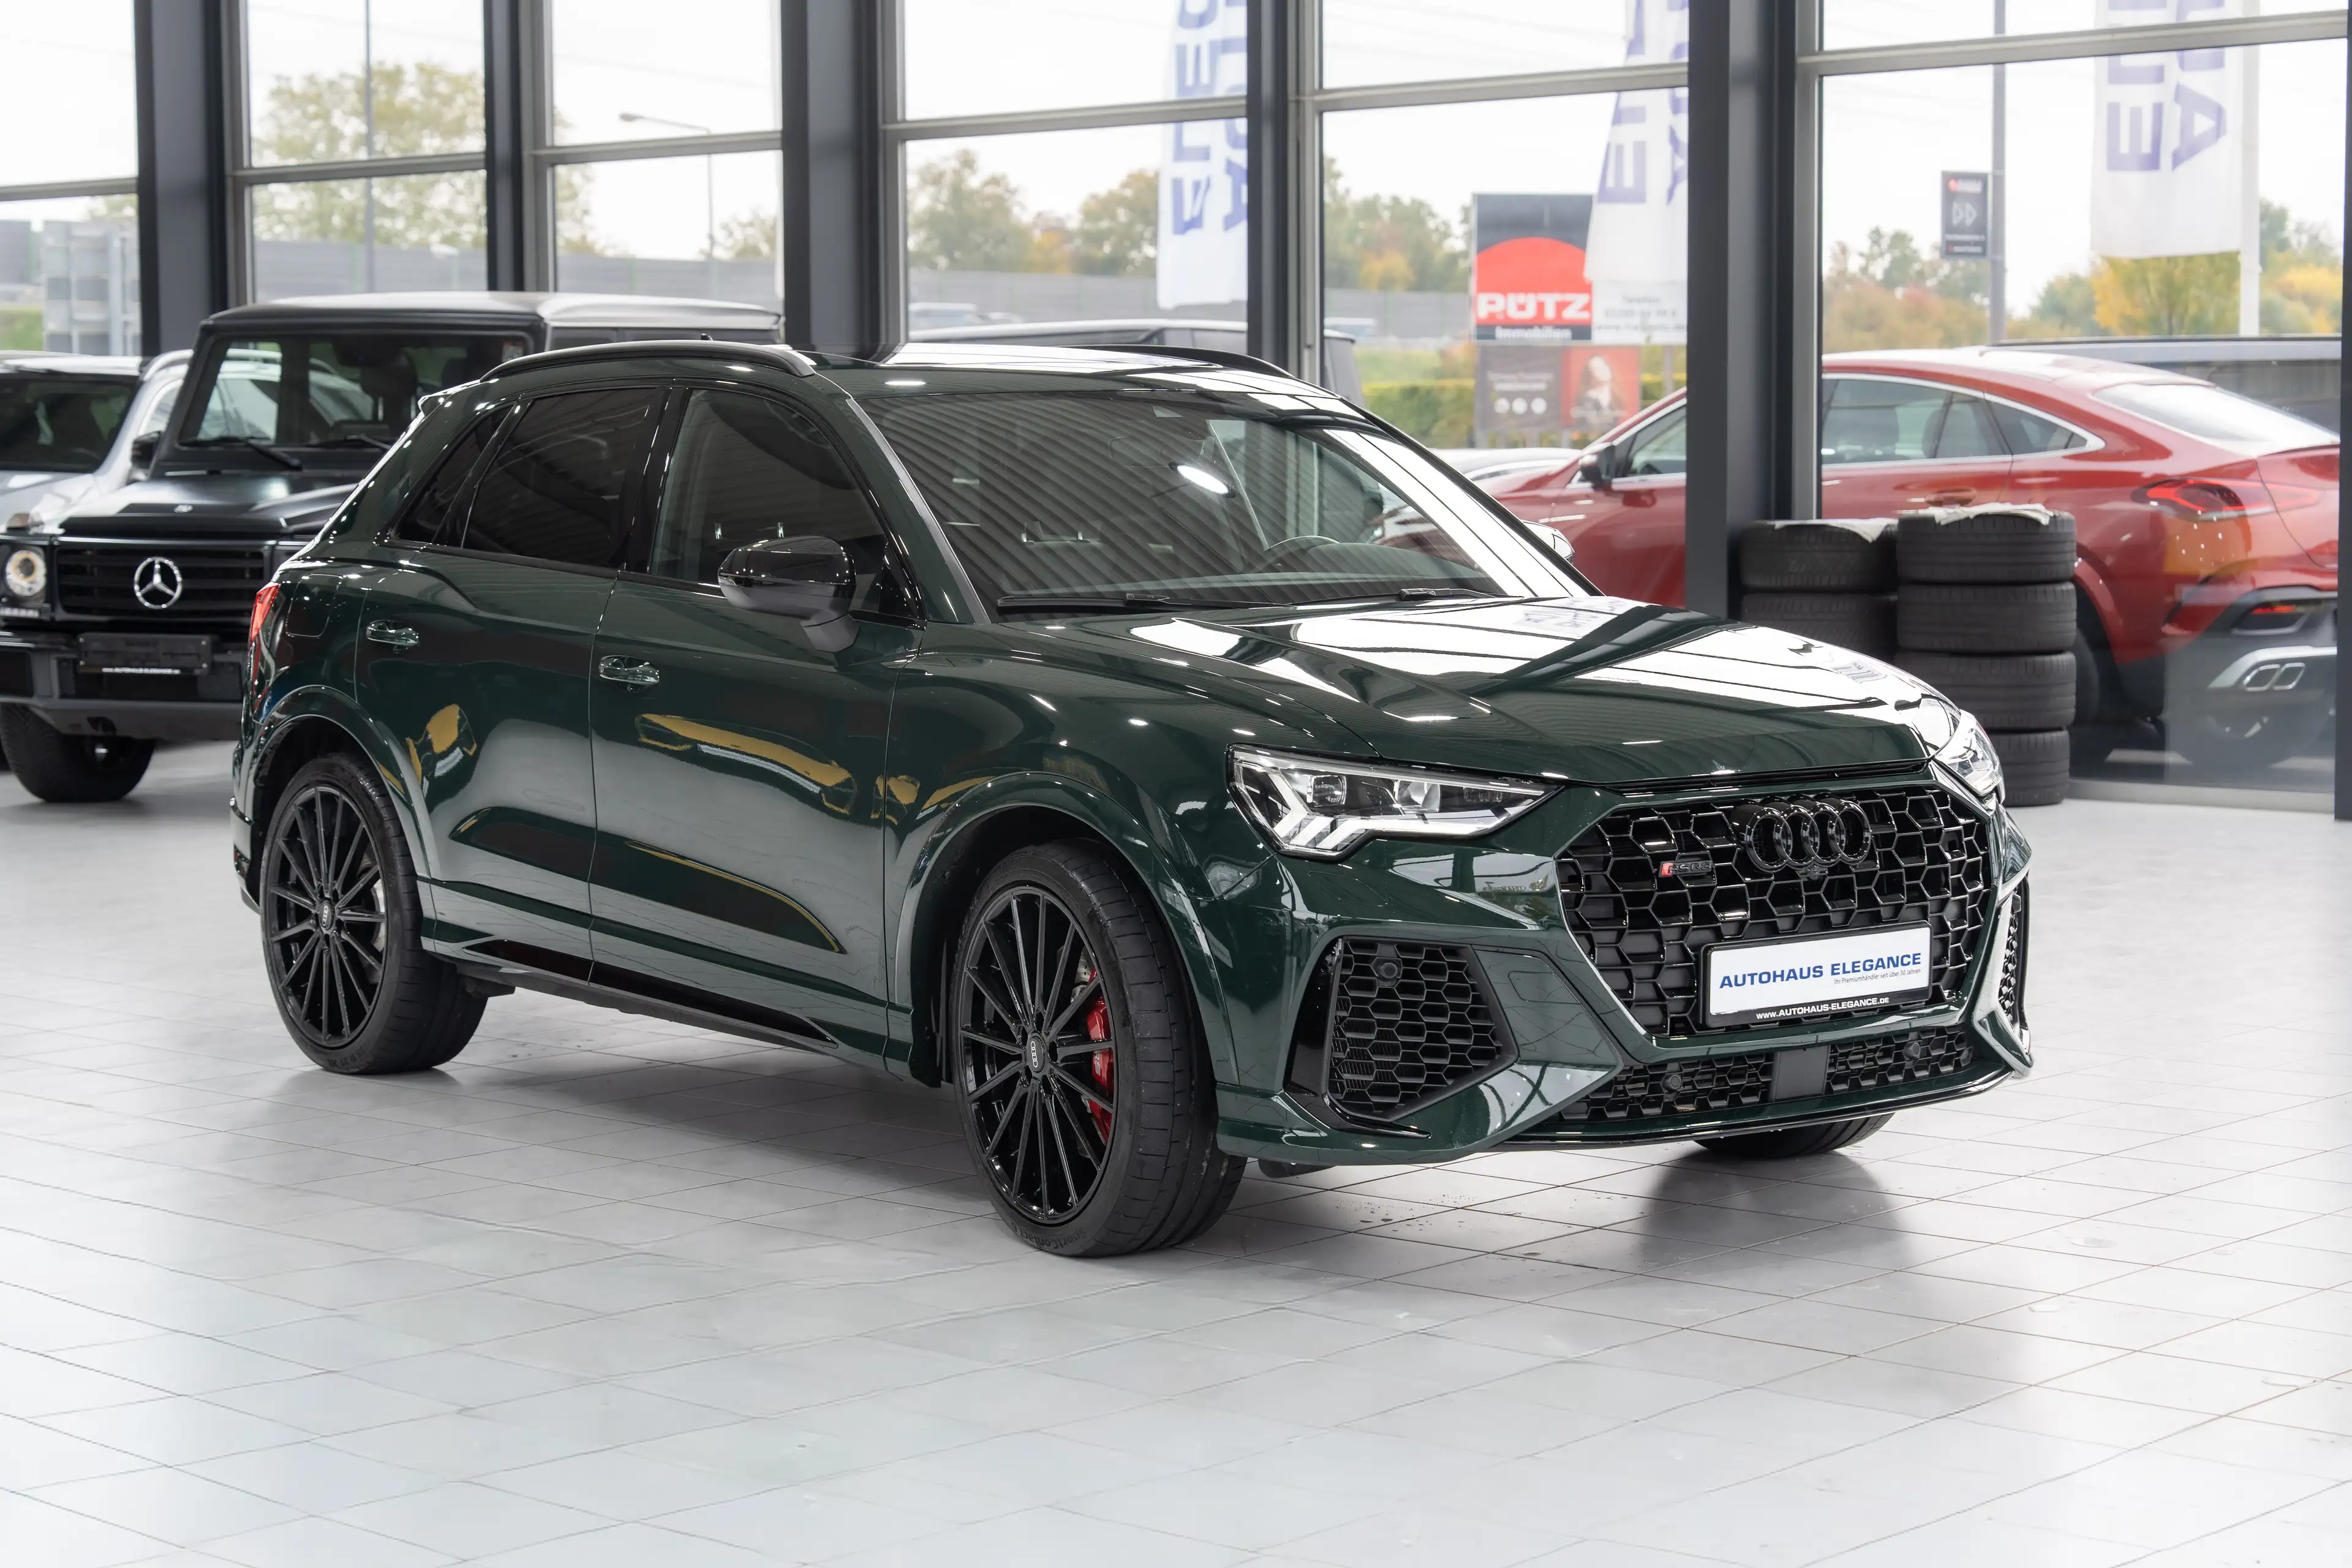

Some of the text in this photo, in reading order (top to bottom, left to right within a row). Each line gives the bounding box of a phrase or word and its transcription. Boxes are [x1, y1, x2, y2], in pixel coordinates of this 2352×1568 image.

[1477, 292, 1591, 320] PÜTZ
[1719, 952, 1921, 989] AUTOHAUS ELEGANCE
[1841, 974, 1880, 984] Premiumhändler
